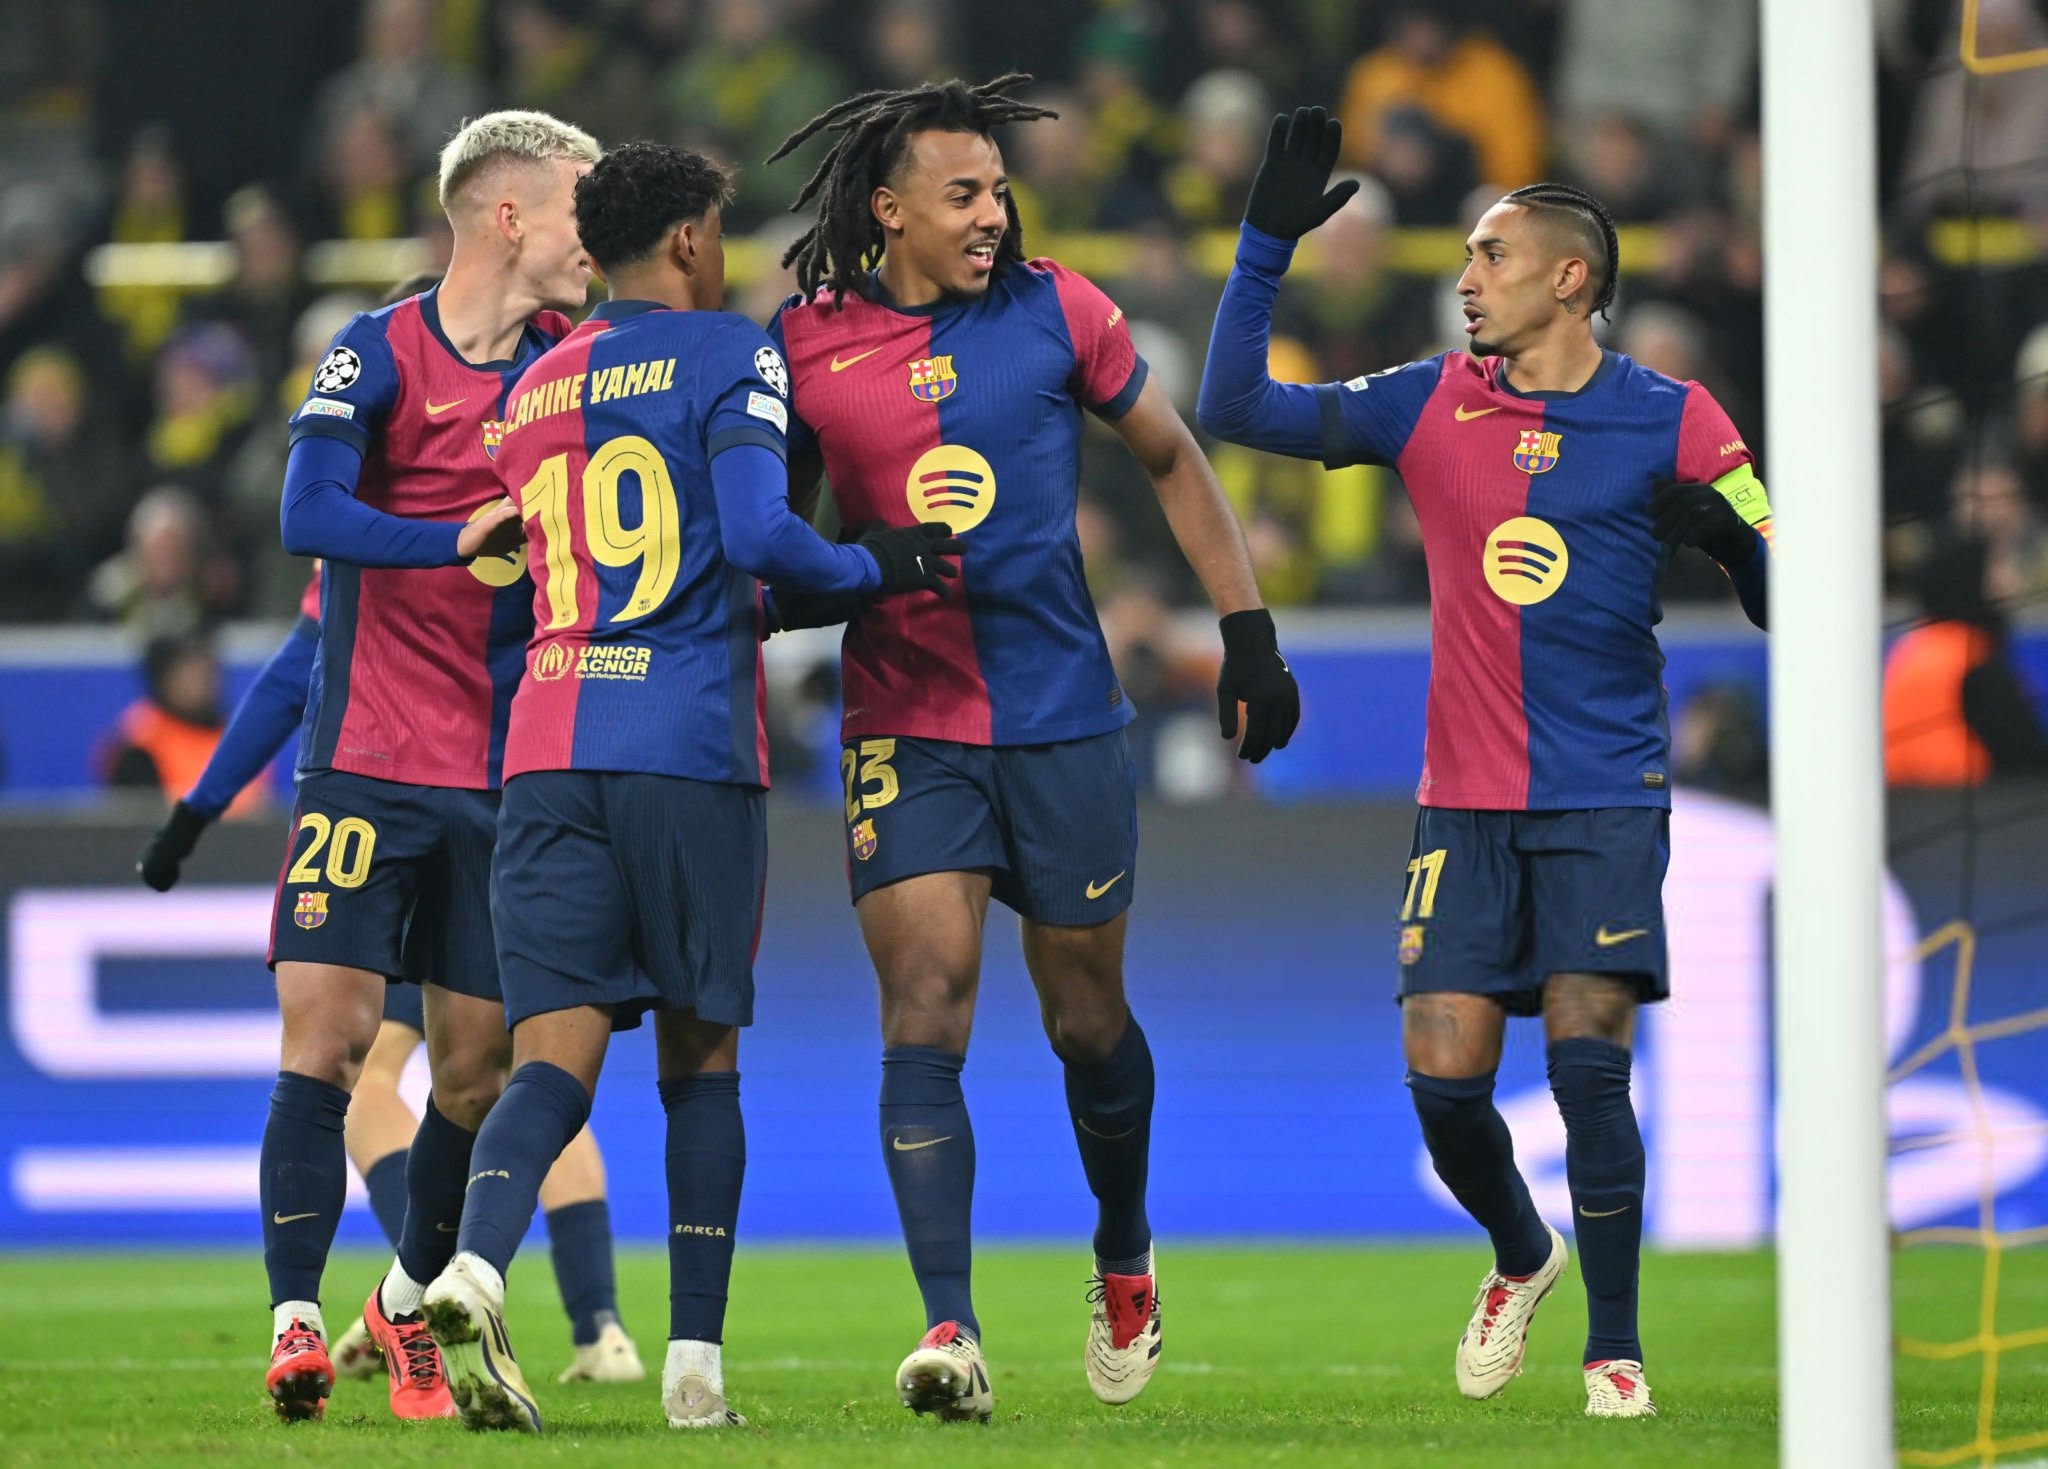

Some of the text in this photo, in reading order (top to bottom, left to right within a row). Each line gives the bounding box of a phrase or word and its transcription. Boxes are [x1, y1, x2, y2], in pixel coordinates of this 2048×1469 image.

[505, 358, 677, 435] LAMINE YAMAL
[520, 435, 681, 630] 19
[574, 658, 648, 674] ACNUR
[578, 646, 652, 662] UNHCR
[622, 673, 646, 682] Agency
[841, 738, 900, 824] 23
[287, 812, 377, 888] 20
[1400, 849, 1448, 922] 11
